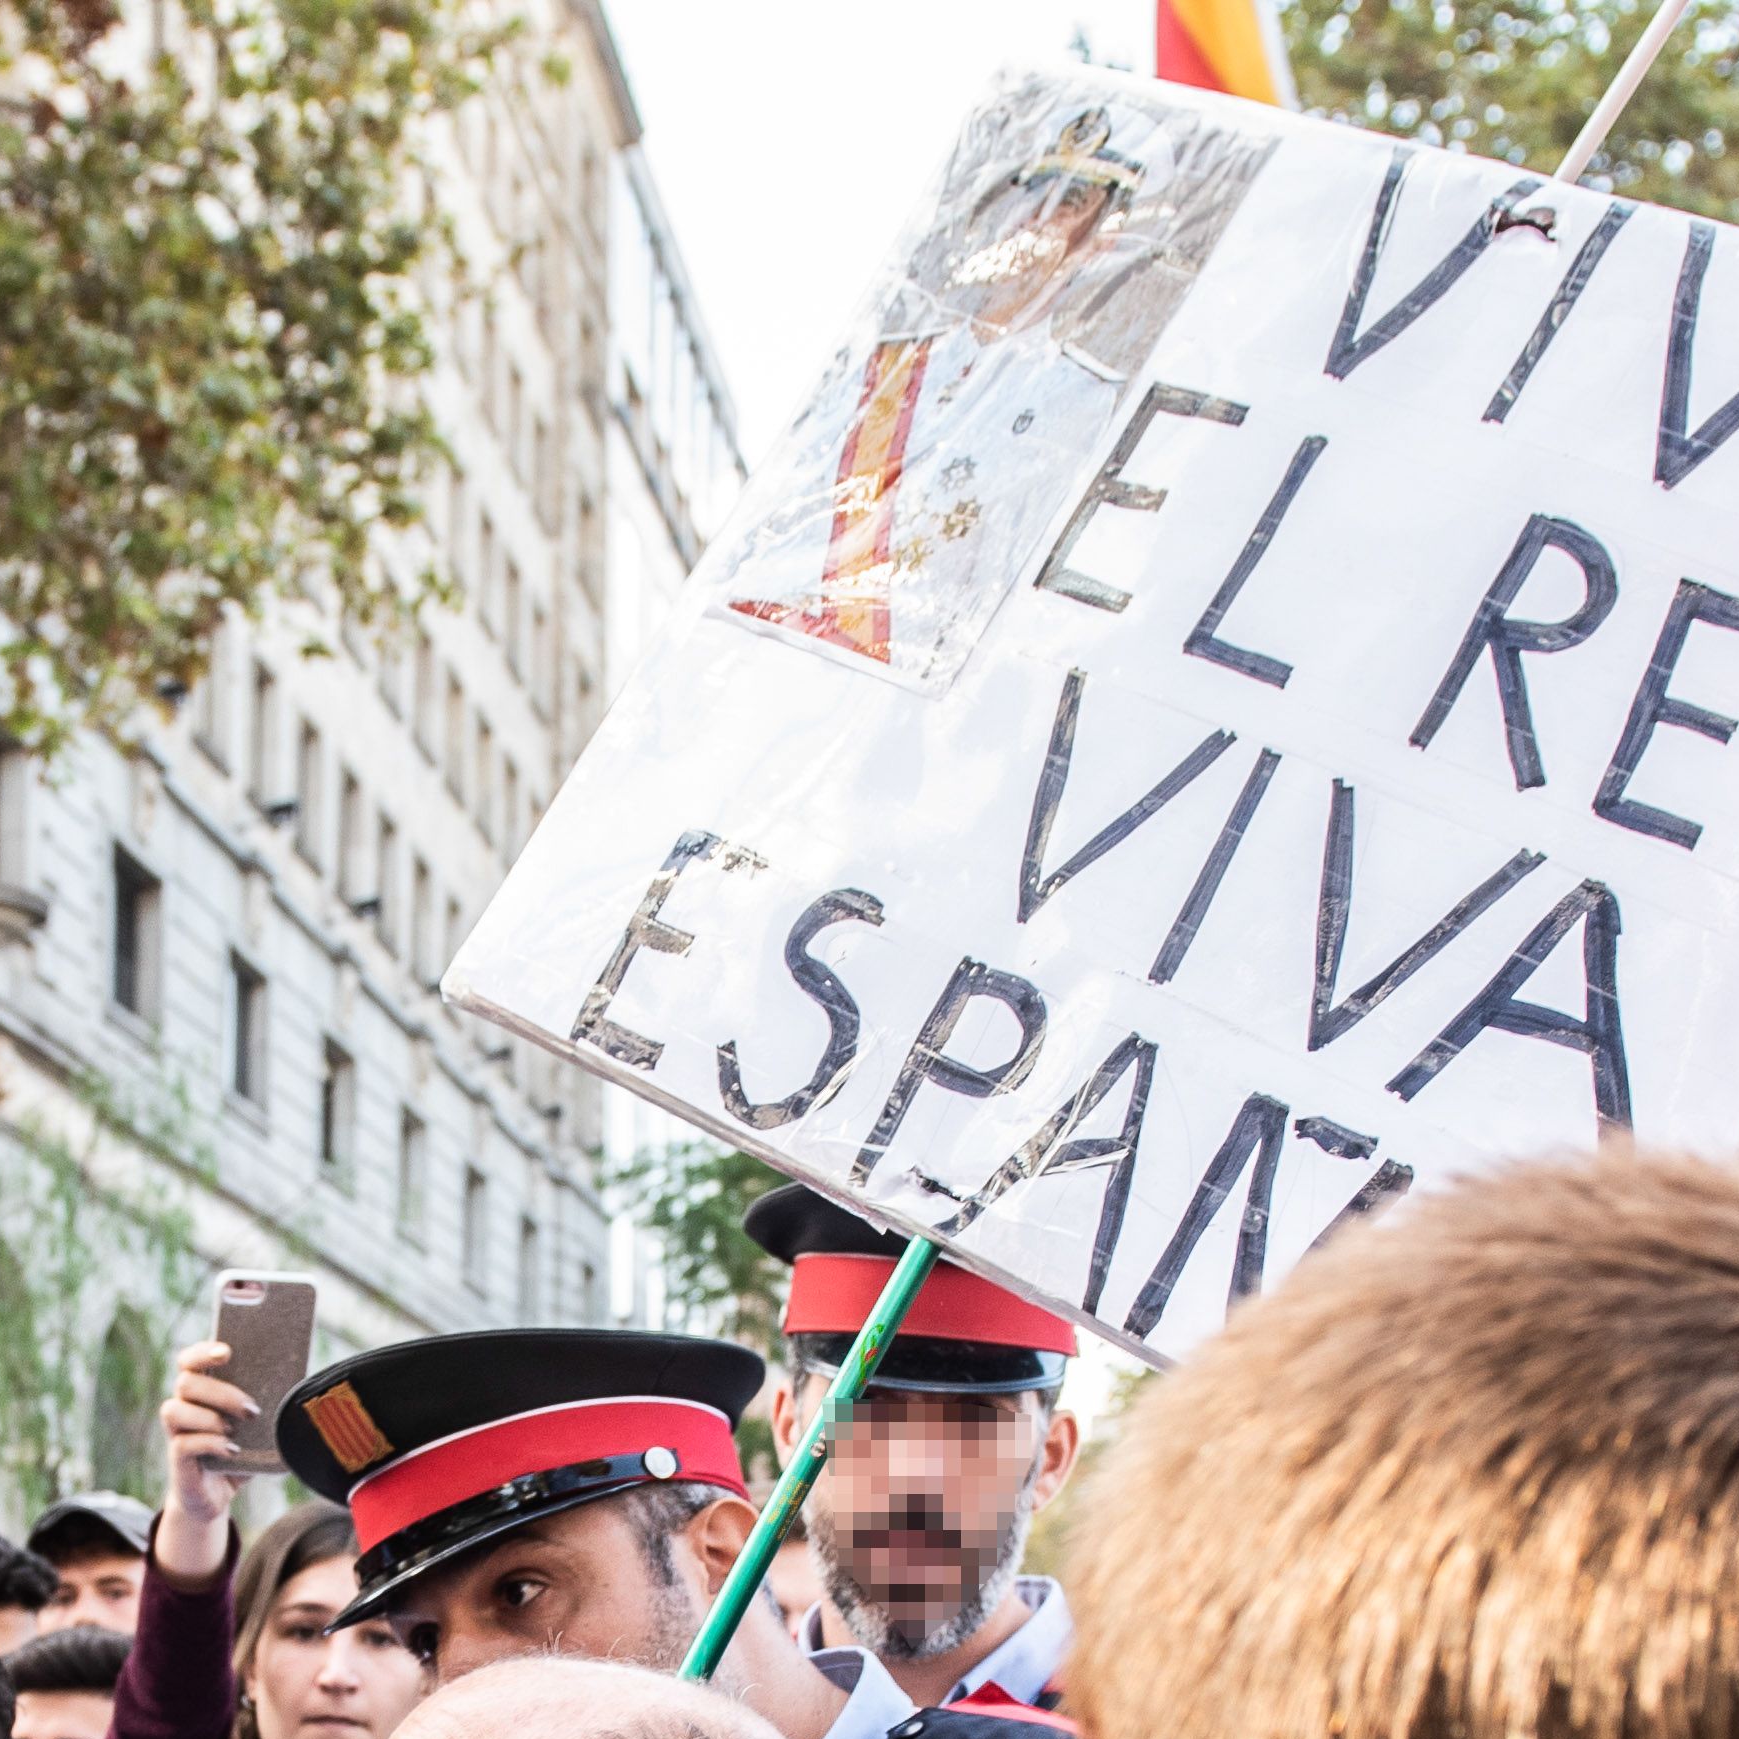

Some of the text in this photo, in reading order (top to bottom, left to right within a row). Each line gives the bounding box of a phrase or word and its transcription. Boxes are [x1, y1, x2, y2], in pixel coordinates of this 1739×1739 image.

[1033, 382, 1328, 689] EL
[571, 829, 1415, 1340] ESPAÑ
[1017, 666, 1635, 1140] VIVA
